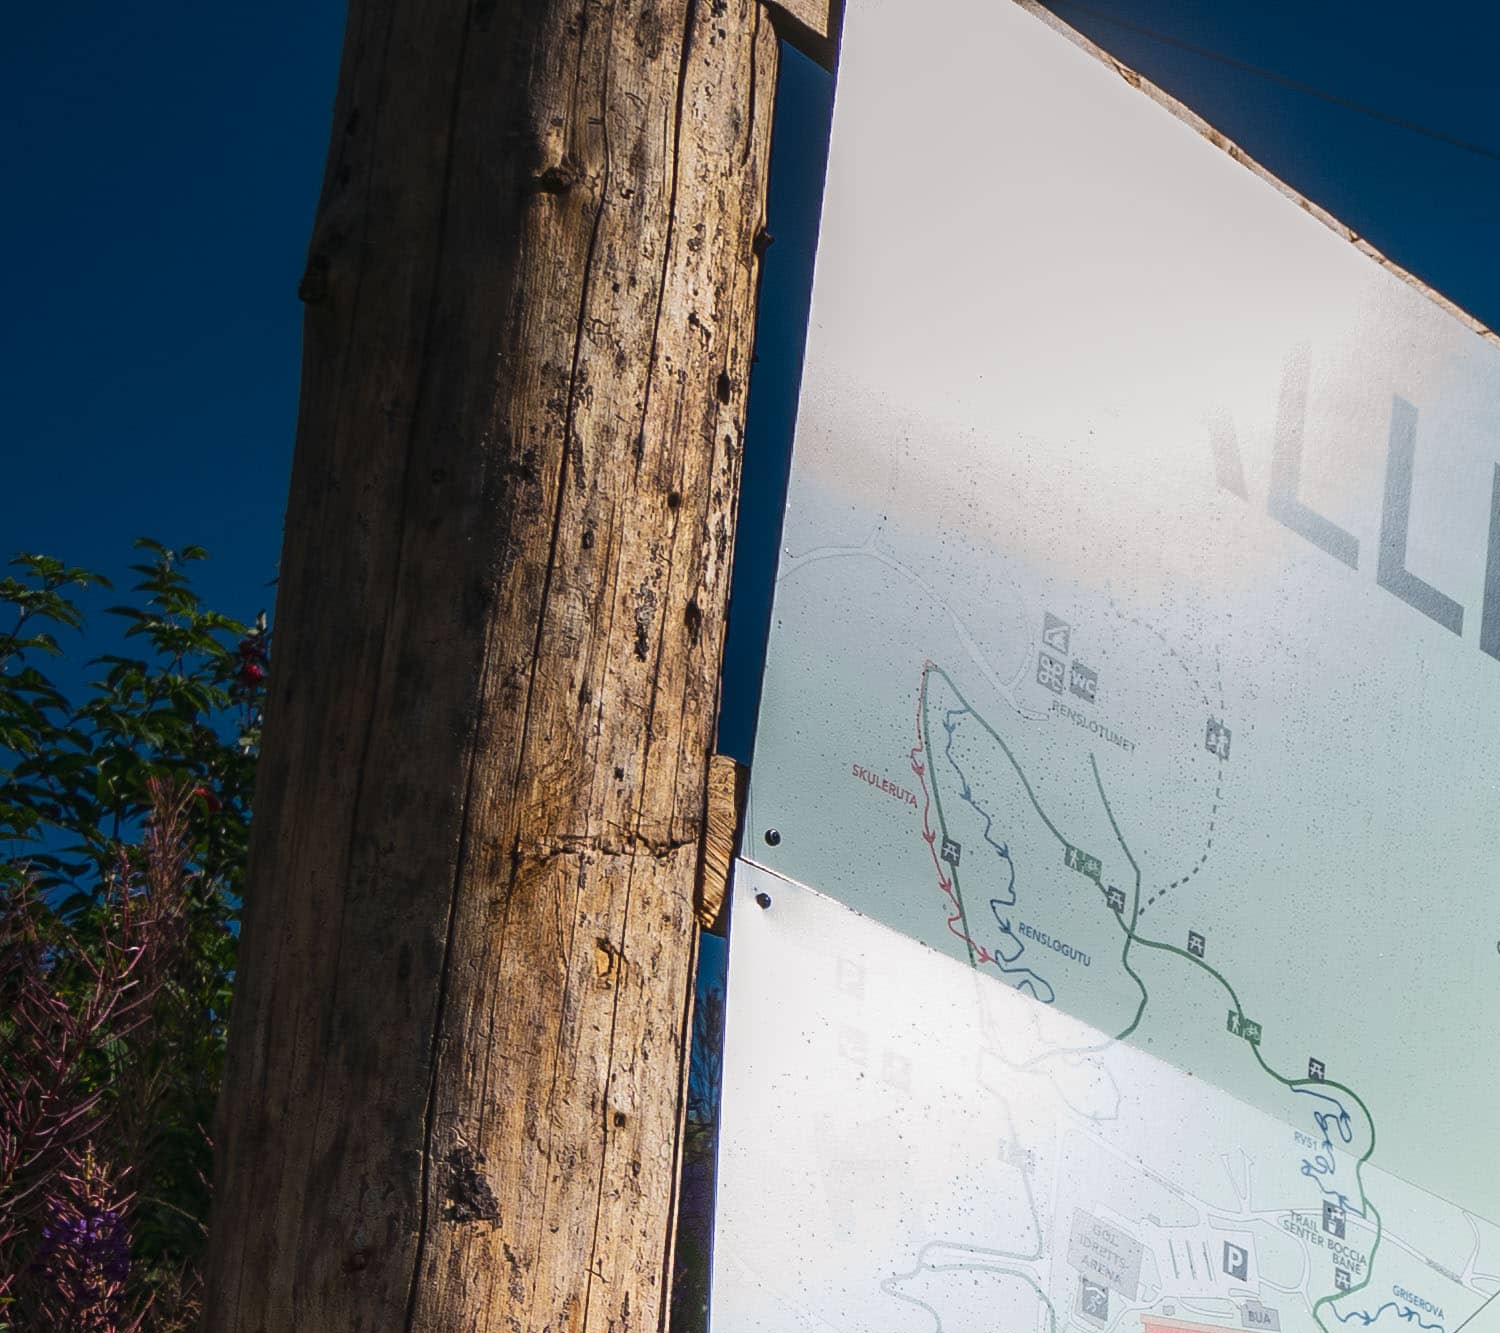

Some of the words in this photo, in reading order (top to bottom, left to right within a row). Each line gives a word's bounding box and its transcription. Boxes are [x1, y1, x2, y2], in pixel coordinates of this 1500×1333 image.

[852, 764, 918, 809] SKULERUTA
[1018, 922, 1092, 967] RENSLOGUTU
[1294, 1131, 1318, 1150] RV51
[1283, 1220, 1324, 1247] SENTER
[1291, 1210, 1319, 1234] TRAIL
[1327, 1239, 1367, 1266] BOCCIA
[1332, 1252, 1362, 1275] BANE
[1393, 1285, 1445, 1320] GRISEROVA
[1248, 1310, 1272, 1325] BUA
